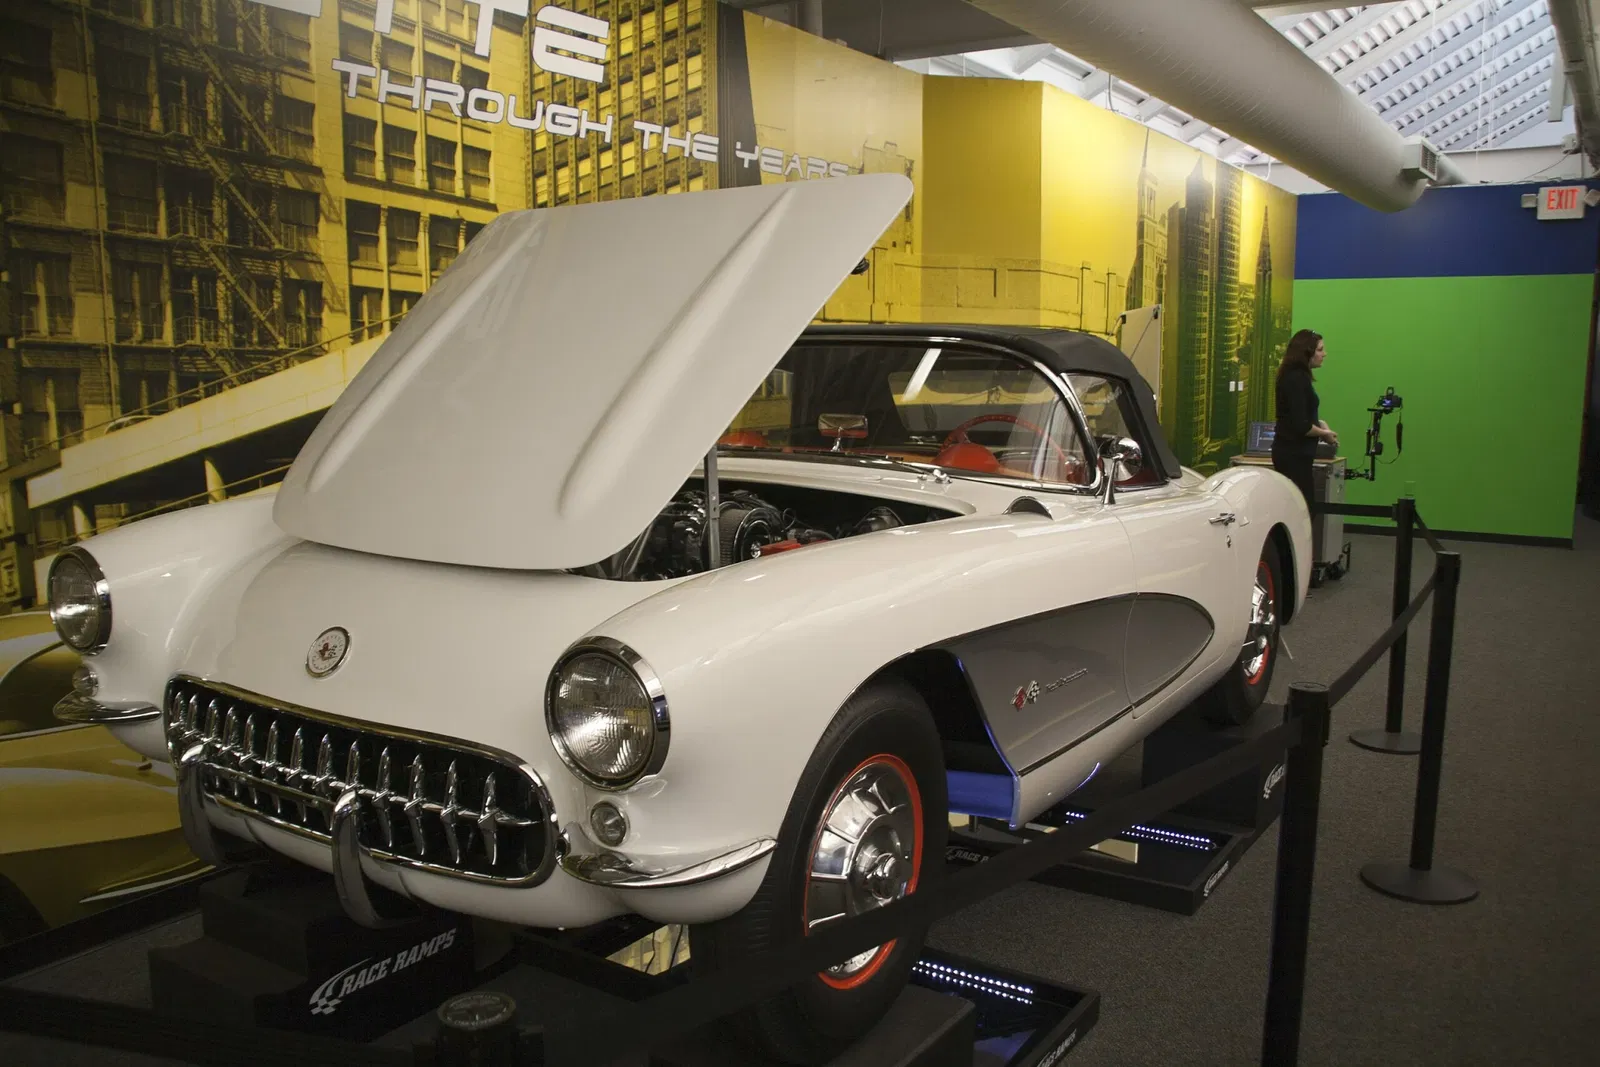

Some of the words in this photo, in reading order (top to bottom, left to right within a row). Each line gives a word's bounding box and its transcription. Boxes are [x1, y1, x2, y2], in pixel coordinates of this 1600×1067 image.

[248, 0, 609, 83] TE
[331, 57, 613, 144] THROUGH
[633, 120, 720, 163] THE
[735, 141, 850, 180] YEARS
[1547, 188, 1580, 210] EXIT
[338, 957, 392, 999] RACE
[392, 927, 457, 973] RAMPS
